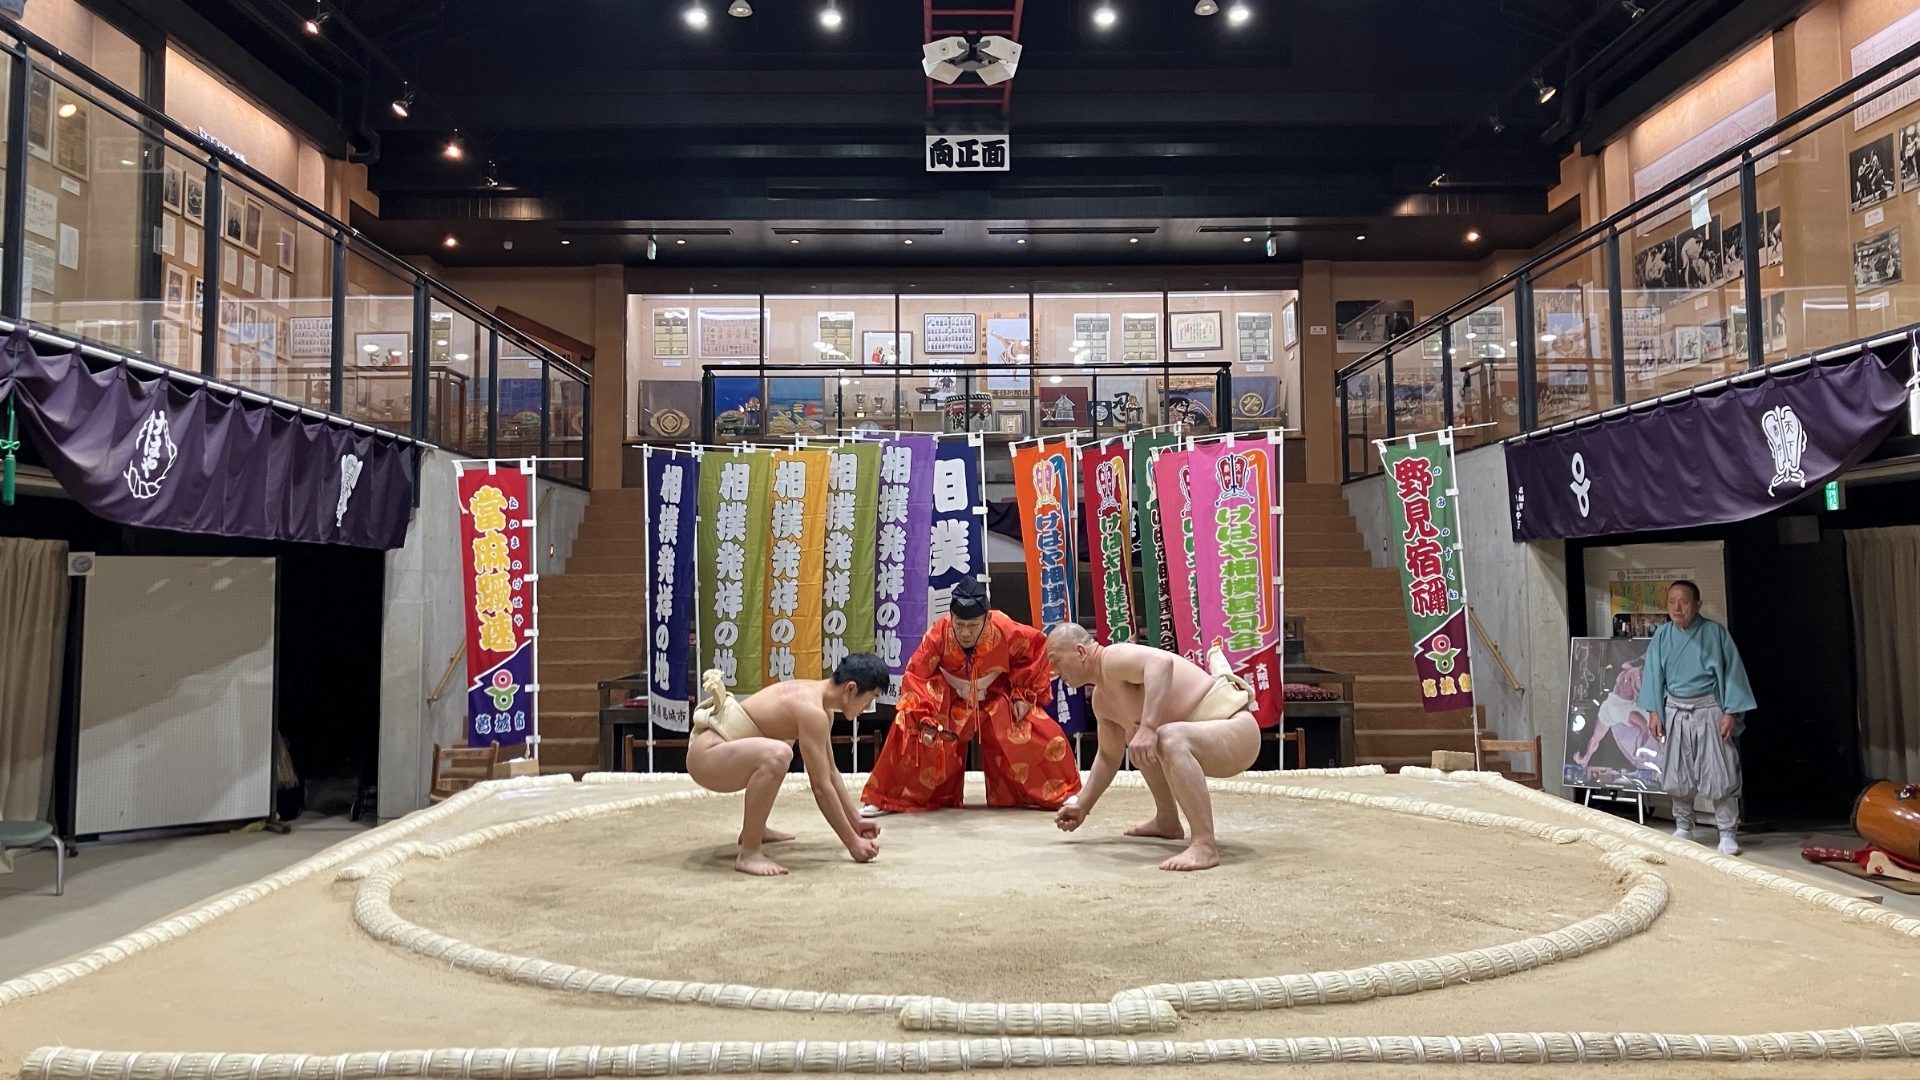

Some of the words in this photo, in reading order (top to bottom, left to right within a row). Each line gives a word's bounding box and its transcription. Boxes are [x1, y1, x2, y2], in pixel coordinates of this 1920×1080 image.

[930, 138, 1006, 168] 向正面
[141, 410, 165, 479] けはや
[1784, 420, 1795, 454] 天下
[508, 497, 524, 626] たいまのけはや
[655, 464, 683, 691] 相撲発祥の地
[713, 462, 750, 687] 相撲発祥の地
[768, 461, 807, 681] 相撲発祥の地
[823, 453, 857, 672] 相撲発祥の地
[875, 446, 912, 667] 相撲発祥の地
[1215, 505, 1263, 651] けはや相撲甚句会
[1432, 467, 1459, 600] のみのすくね
[476, 711, 525, 734] 葛城市
[1256, 663, 1269, 690] 大阪市
